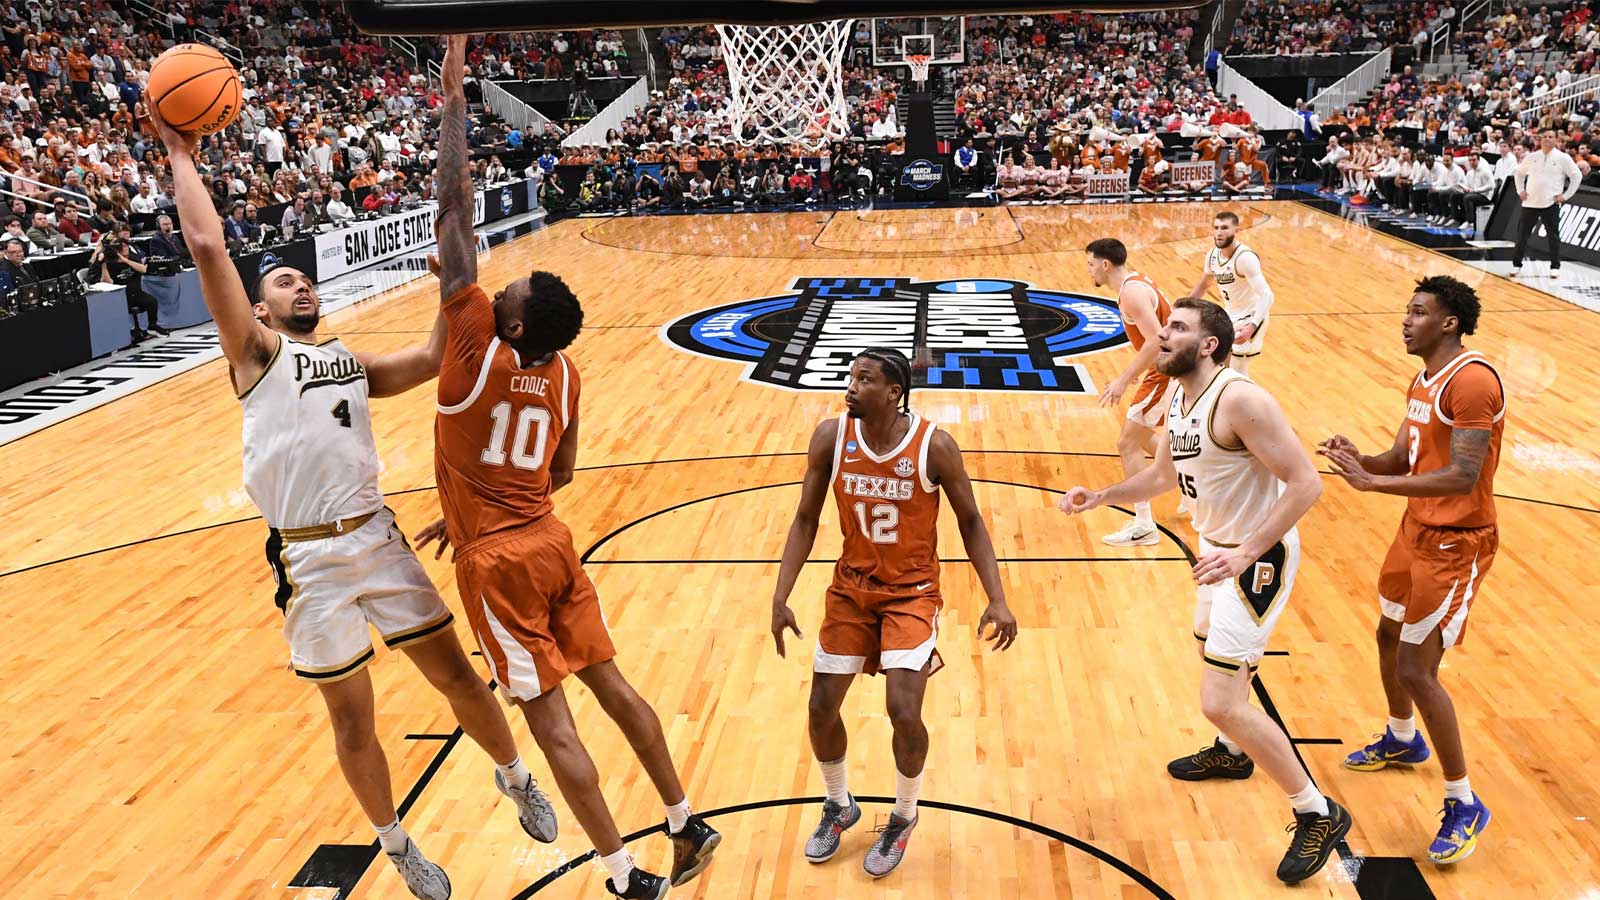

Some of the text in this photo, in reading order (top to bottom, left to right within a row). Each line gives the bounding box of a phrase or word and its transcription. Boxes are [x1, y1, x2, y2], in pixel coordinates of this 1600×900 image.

[911, 167, 931, 175] MARCH
[913, 173, 941, 181] MADNESS
[1173, 165, 1213, 181] DEFENSE
[1089, 178, 1127, 194] DEFENSE
[345, 229, 370, 266] SAN
[372, 221, 401, 257] JOSE
[404, 211, 432, 247] STATE
[700, 313, 752, 331] ELITE
[925, 293, 1030, 350] MARCH
[1061, 302, 1121, 323] SWEET
[89, 333, 220, 371] FINAL
[510, 375, 550, 397] CODIE
[330, 399, 351, 428] 4
[480, 400, 552, 472] 10
[897, 458, 912, 473] SEC
[842, 472, 915, 501] TEXAS
[1177, 471, 1198, 499] 45
[853, 501, 900, 544] 12
[1251, 561, 1275, 594] P
